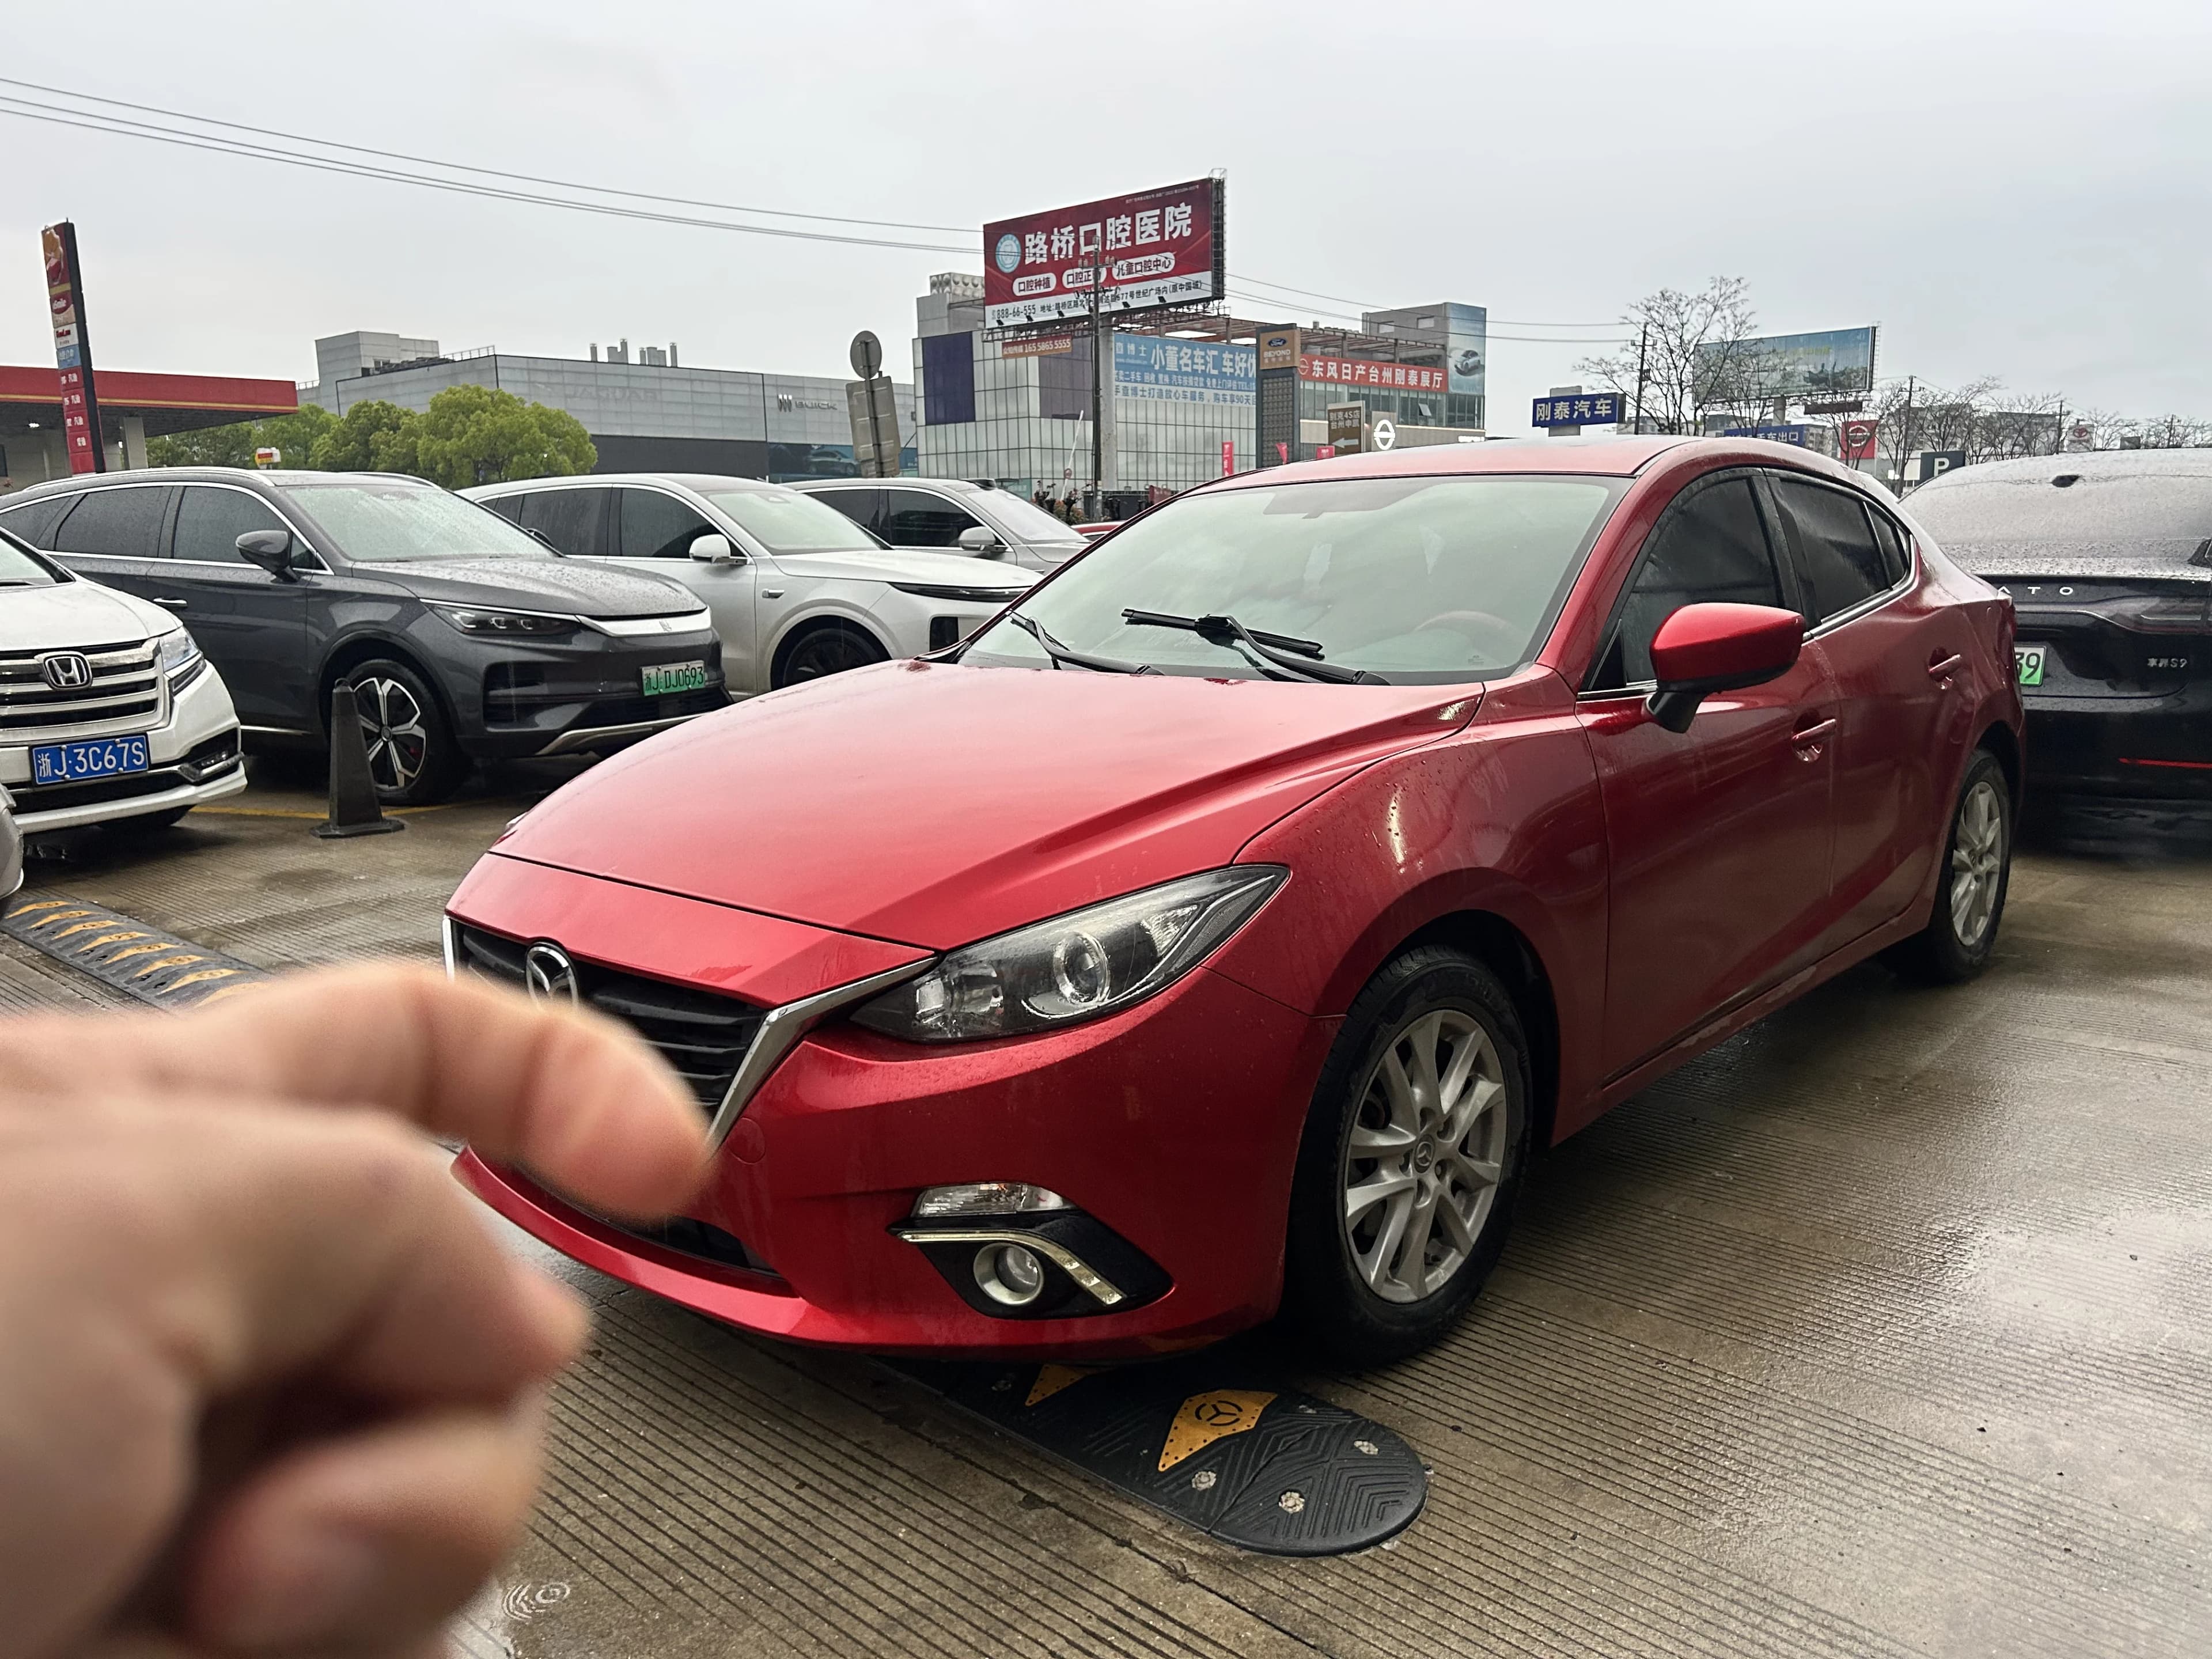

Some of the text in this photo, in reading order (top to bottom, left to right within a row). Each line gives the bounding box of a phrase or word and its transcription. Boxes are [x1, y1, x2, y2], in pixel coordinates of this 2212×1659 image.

[1025, 202, 1191, 265] 路桥口腔医院
[1066, 267, 1103, 285] 口腔正
[1116, 258, 1171, 277] 儿童口腔中心
[1018, 276, 1051, 293] 口腔种植
[1151, 344, 1219, 375] 小董名车汇
[1312, 360, 1443, 389] 东风日产台州刚泰展厅
[1536, 398, 1612, 422] 刚泰汽车
[1934, 457, 1950, 477] P
